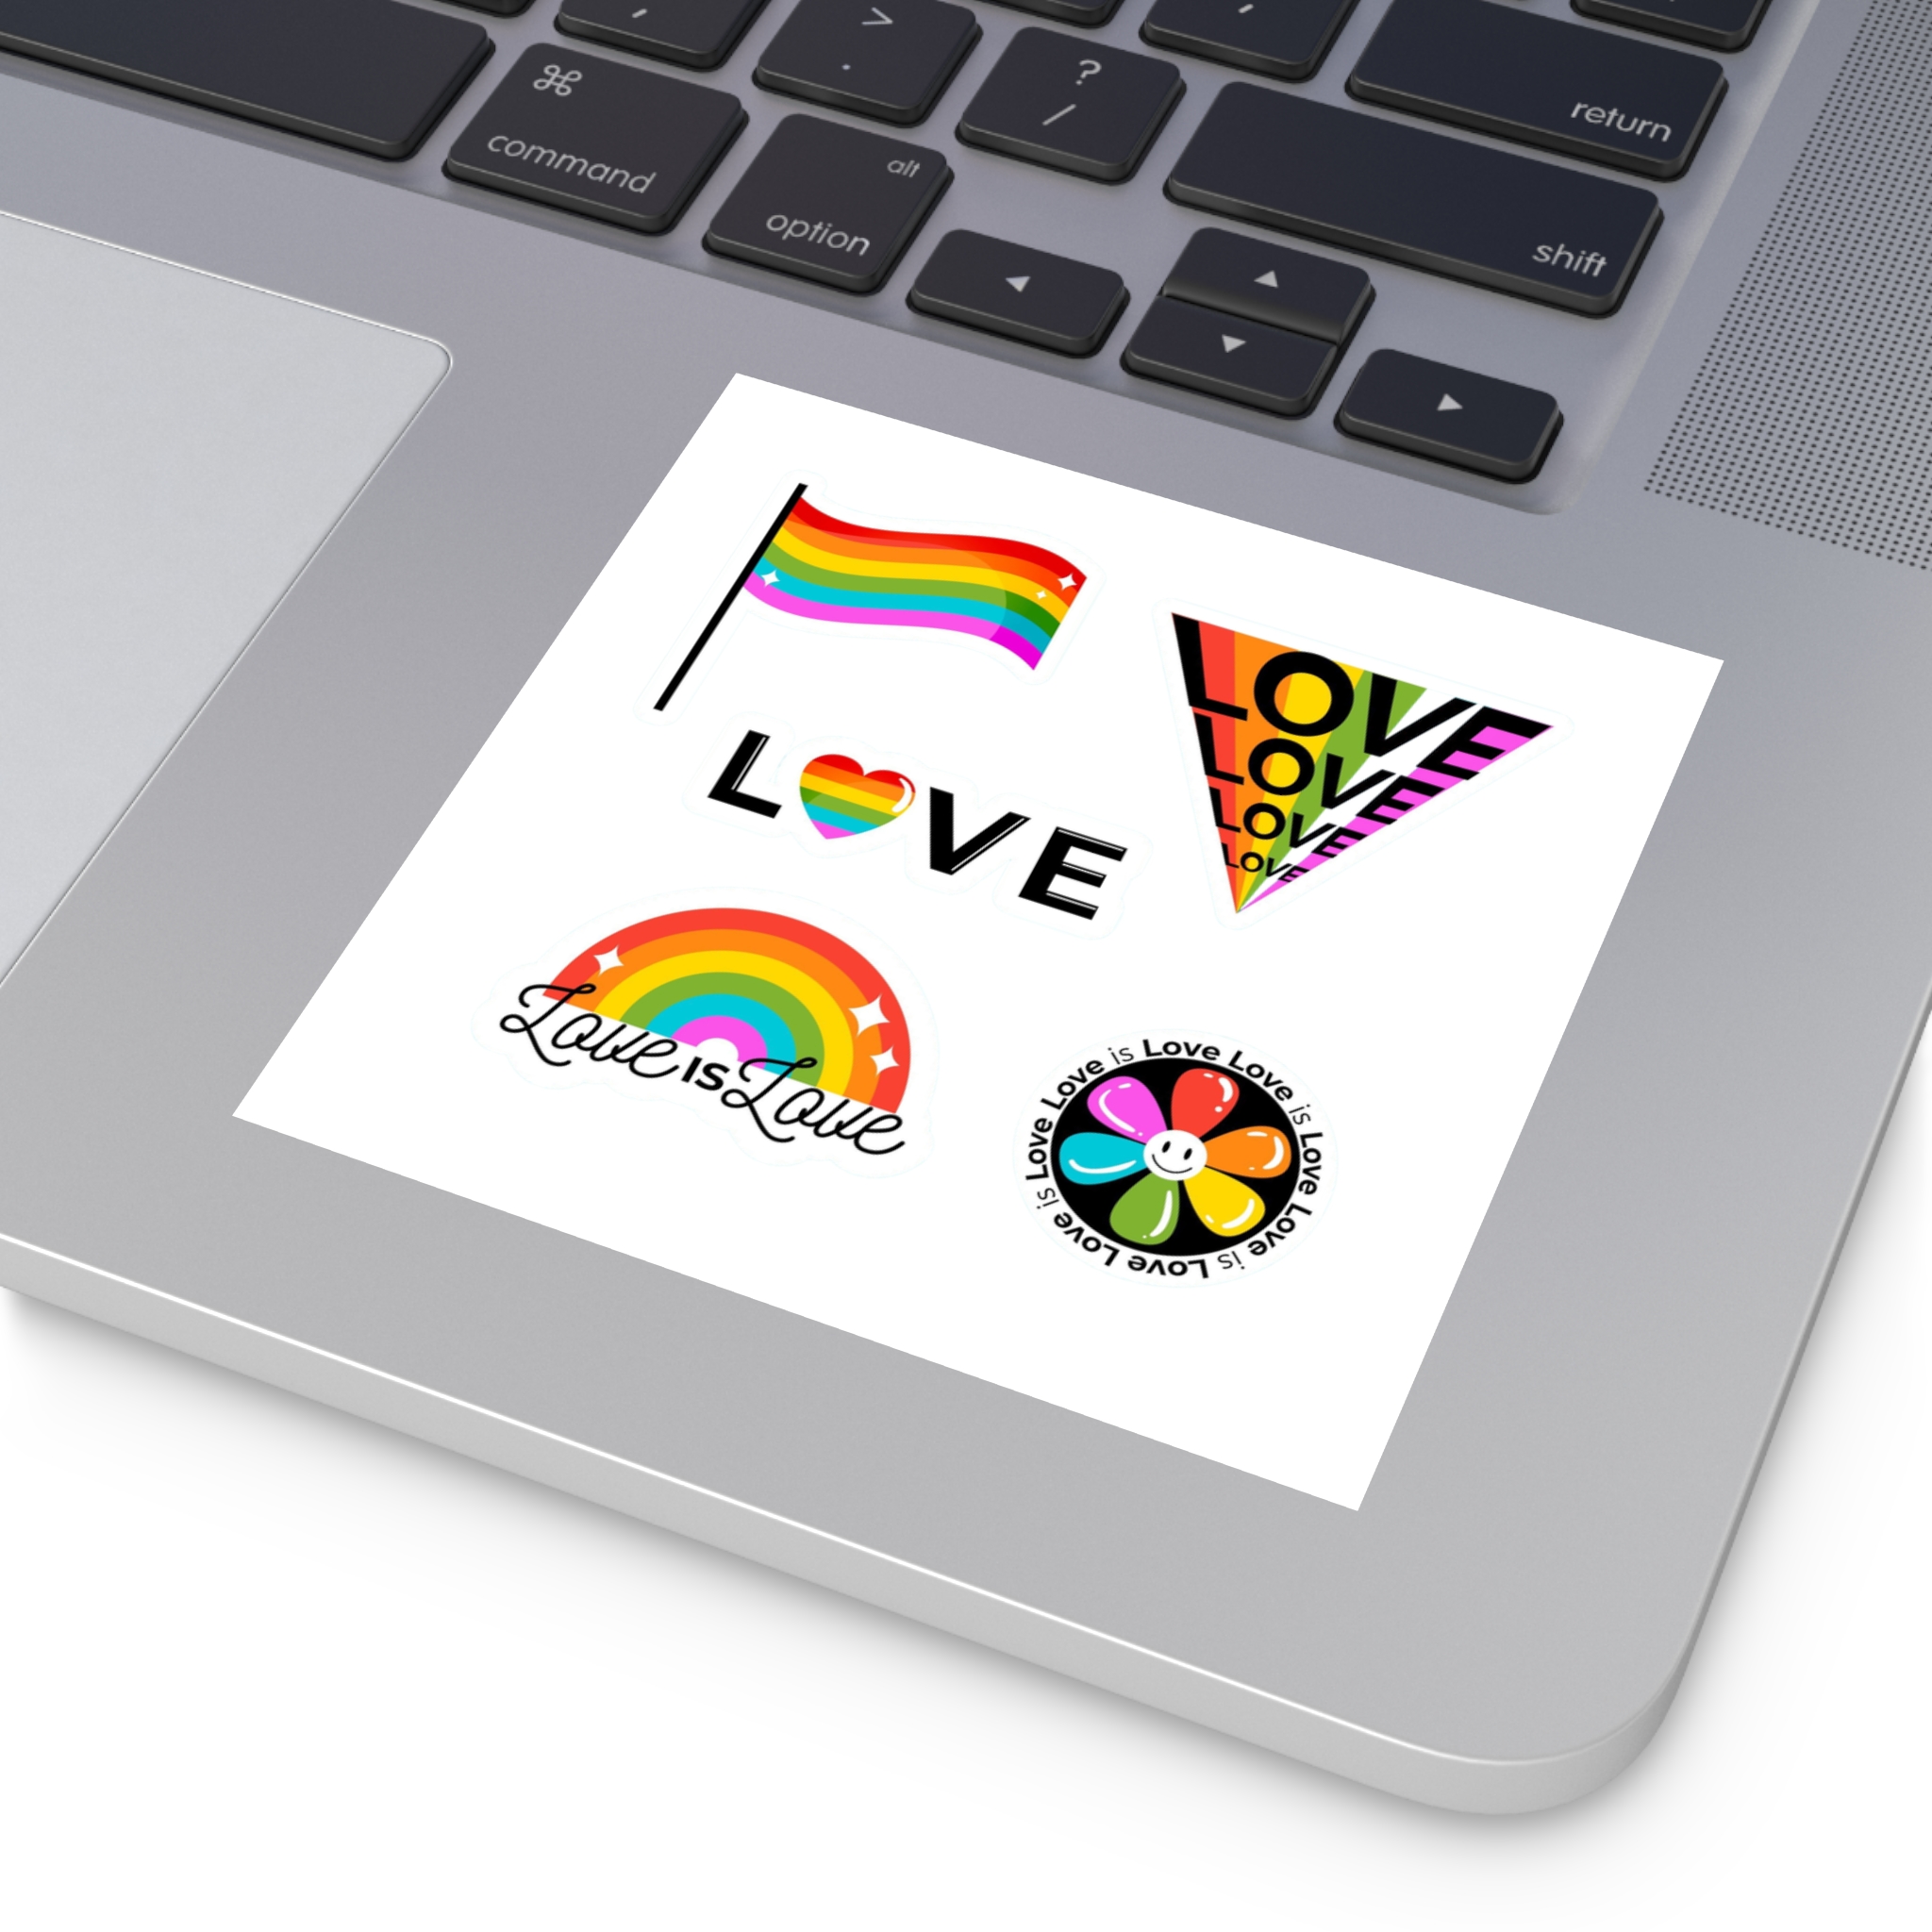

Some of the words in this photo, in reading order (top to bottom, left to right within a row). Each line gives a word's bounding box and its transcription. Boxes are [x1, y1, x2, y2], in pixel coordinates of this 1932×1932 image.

[860, 7, 894, 26] >
[1074, 59, 1102, 86] ?
[1041, 104, 1076, 126] /
[1571, 100, 1672, 143] return
[487, 133, 657, 194] command
[887, 156, 921, 179] alt
[766, 210, 871, 257] option
[1532, 242, 1608, 279] shift
[1172, 612, 1554, 780] LOVE
[1193, 712, 1446, 825] LOVE
[1208, 786, 1368, 858] LOVE
[1221, 842, 1310, 883] LOVE
[500, 983, 679, 1077] Love
[721, 1057, 906, 1155] Love
[1041, 1059, 1105, 1111] Love
[1108, 1046, 1135, 1065] is
[1142, 1039, 1221, 1061] Love
[1228, 1050, 1294, 1102] Love
[1288, 1104, 1311, 1125] is
[1025, 1117, 1053, 1180] Love
[1298, 1132, 1324, 1196] Love
[1036, 1187, 1059, 1209] is
[1053, 1211, 1121, 1267] Love
[1247, 1202, 1313, 1257] Love
[1127, 1255, 1209, 1279] Love
[1217, 1251, 1245, 1270] is
